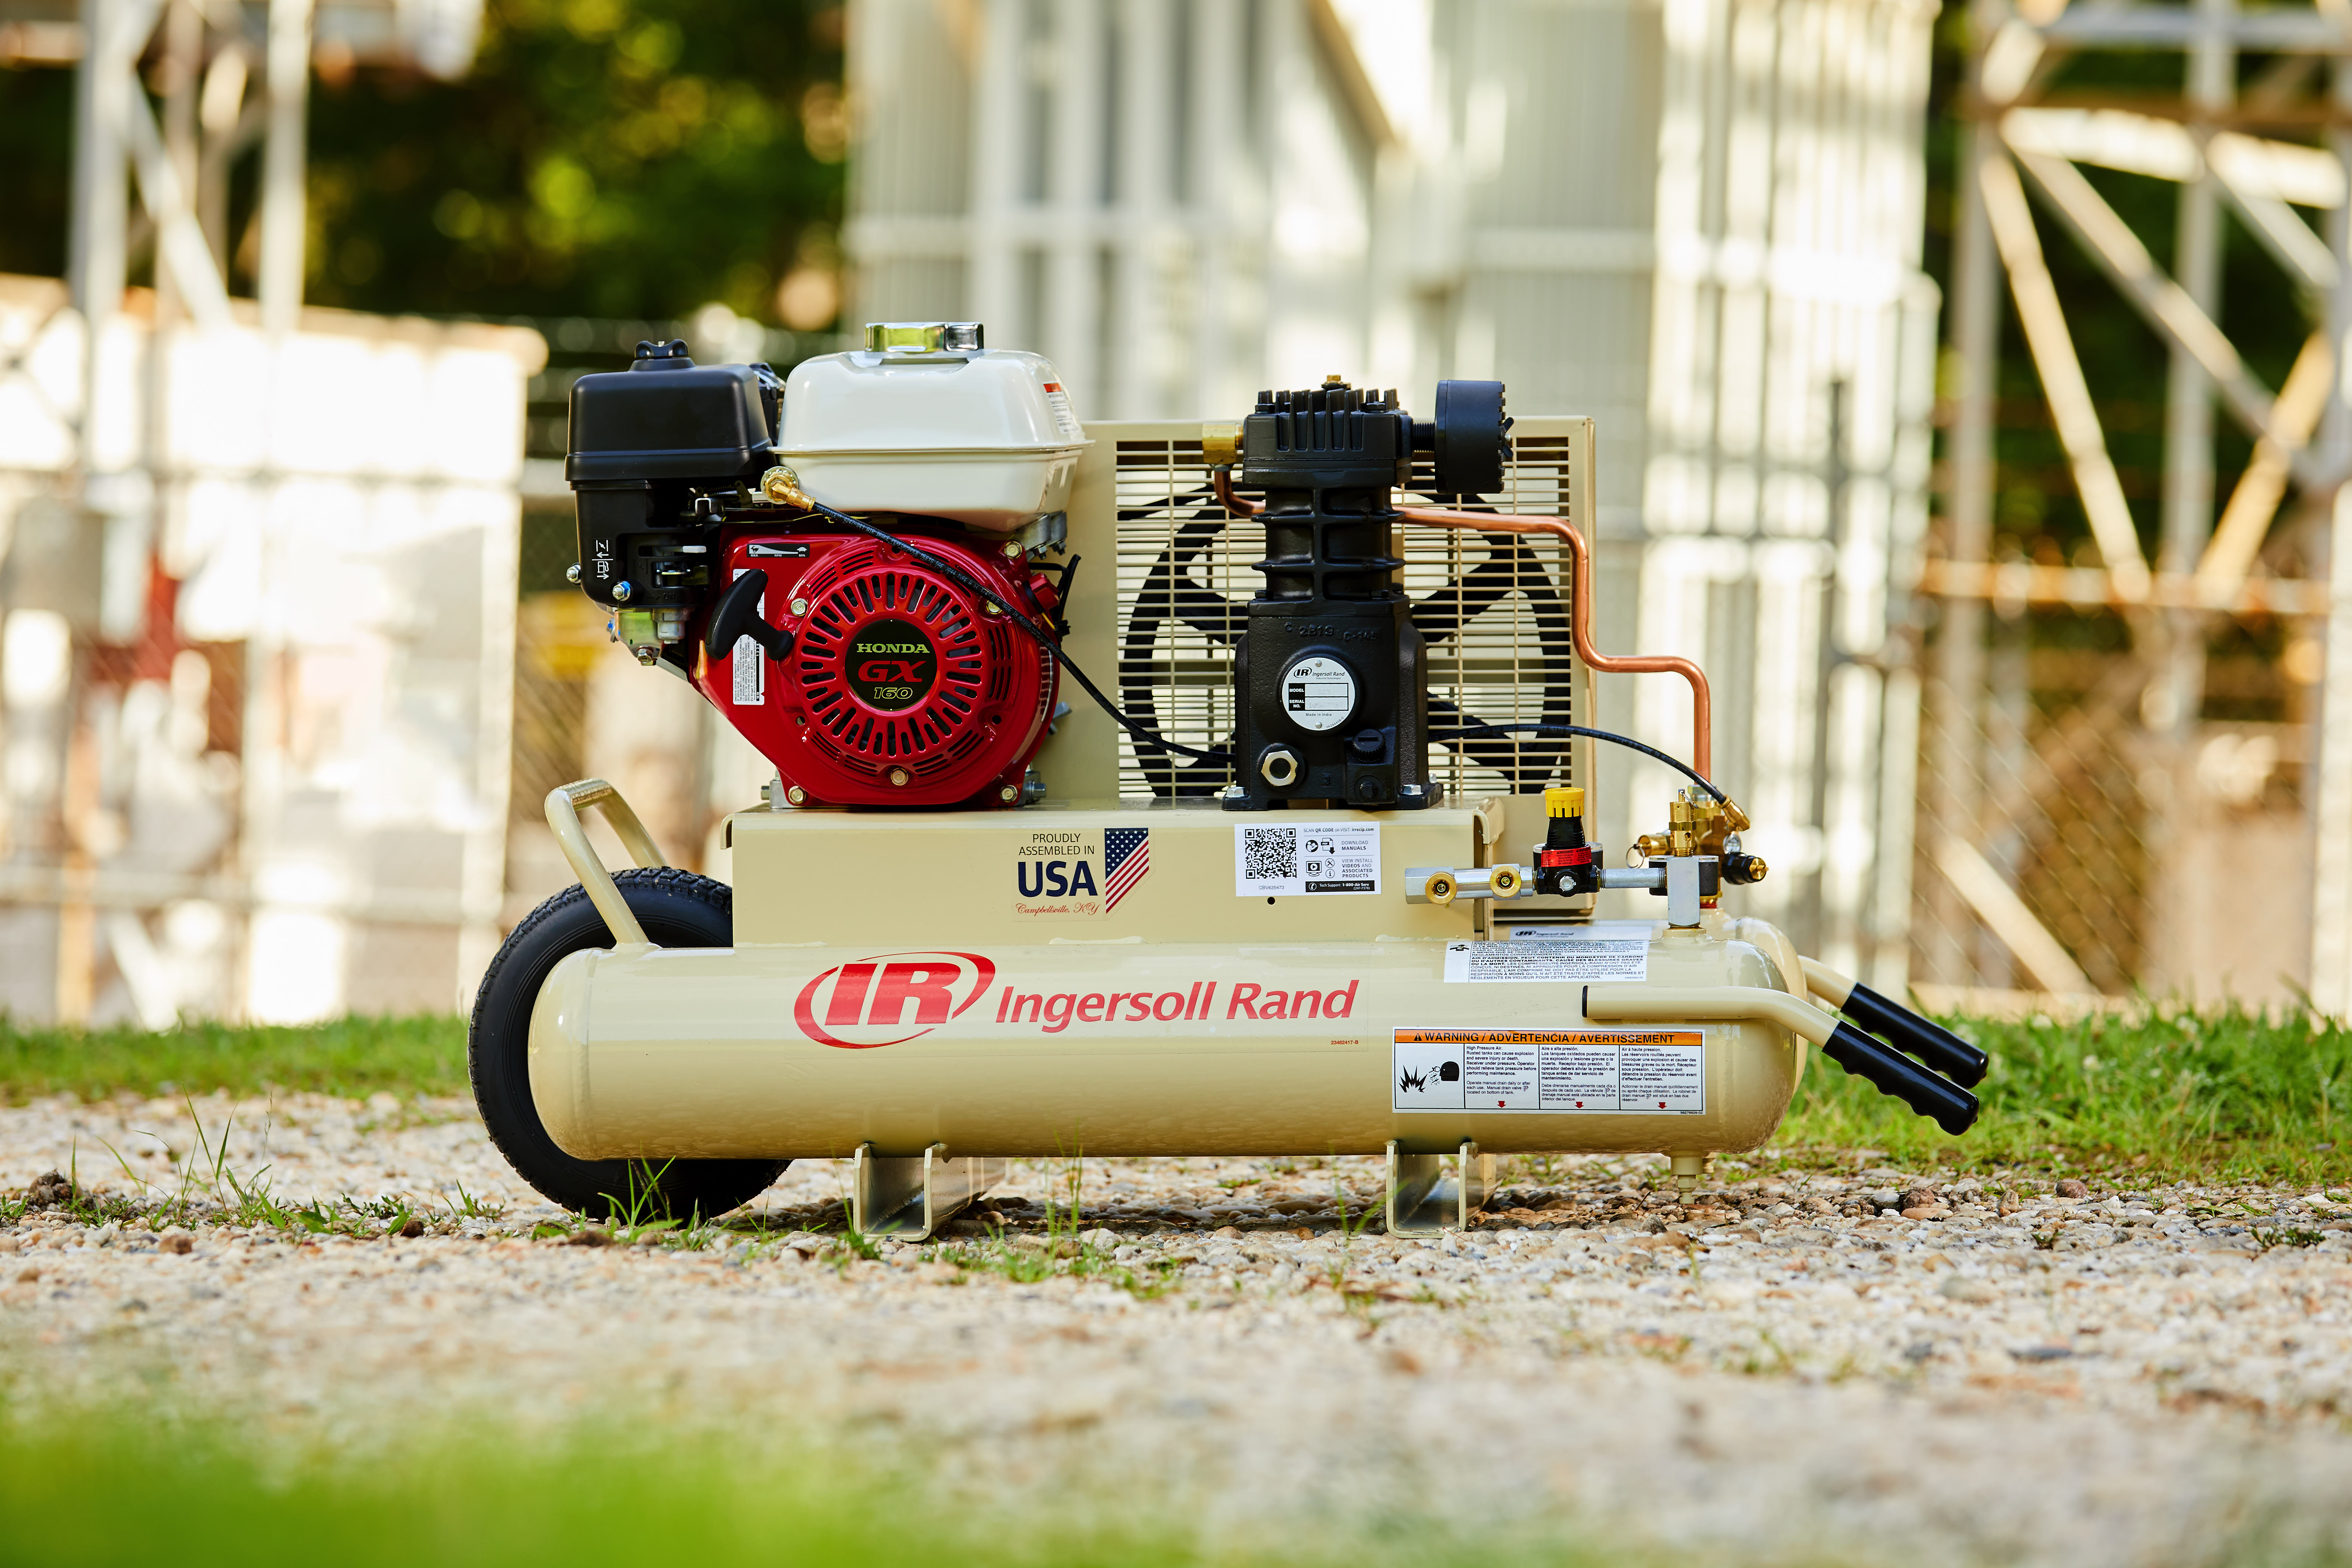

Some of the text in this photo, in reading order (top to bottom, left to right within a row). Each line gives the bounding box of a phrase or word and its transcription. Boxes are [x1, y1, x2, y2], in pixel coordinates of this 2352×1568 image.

[865, 526, 875, 534] AIR
[857, 643, 930, 653] HONDA
[858, 660, 927, 682] GX
[874, 687, 913, 699] 160
[1033, 833, 1080, 843] PROUDLY
[1018, 845, 1094, 855] ASSEMBLED IN
[1018, 861, 1098, 897] USA
[1073, 902, 1101, 915] KY
[996, 982, 1217, 1033] Ingersoll
[1227, 980, 1359, 1019] Rand
[1425, 1033, 1674, 1043] WARNING / ADVERTENCIA / AVERTISSEMENT
